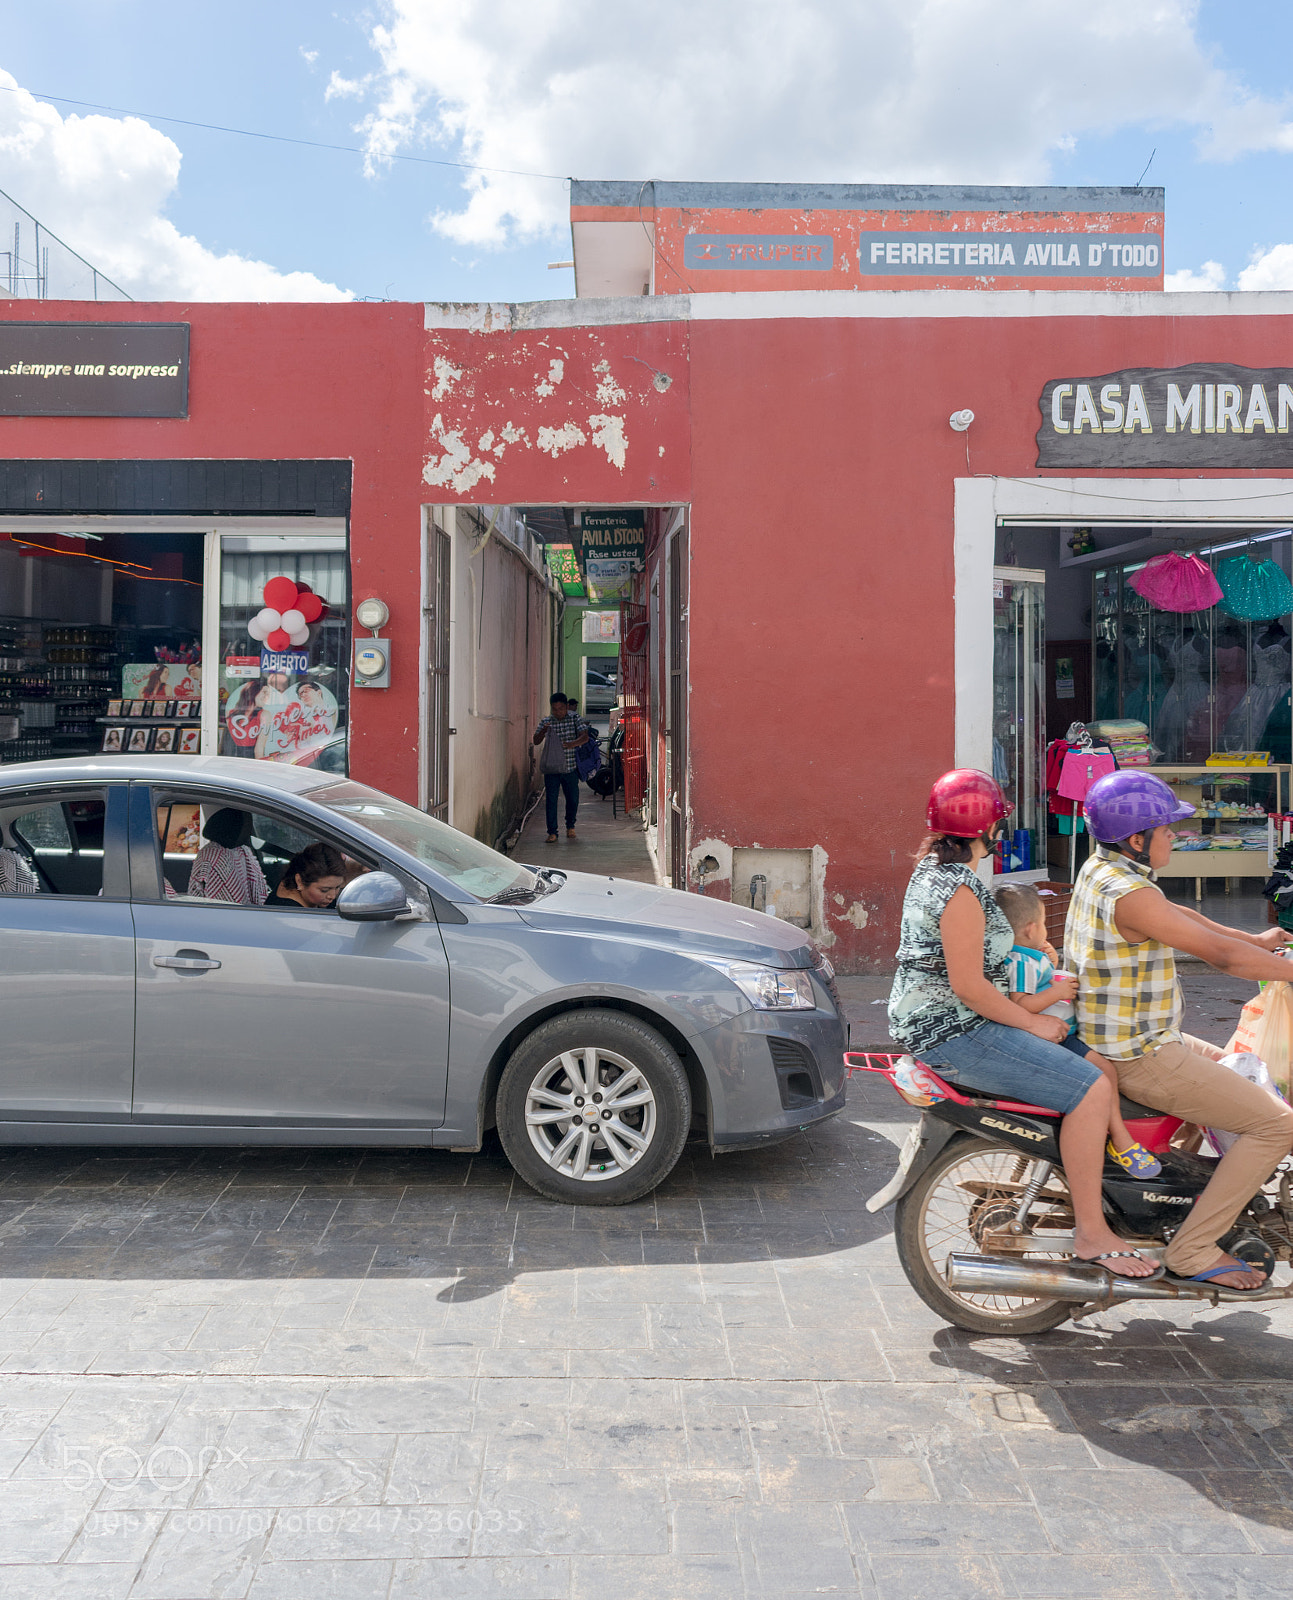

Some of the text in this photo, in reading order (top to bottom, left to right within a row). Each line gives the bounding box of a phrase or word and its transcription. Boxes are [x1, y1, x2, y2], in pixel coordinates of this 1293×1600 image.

[725, 243, 824, 262] TRUPER
[870, 242, 1159, 267] FERRETERIA AVILA D'TODO
[73, 363, 105, 377] una
[107, 364, 179, 380] sorpresa
[1051, 383, 1153, 434] CASA
[581, 529, 613, 546] AVILA
[588, 548, 638, 559] Pase usted
[261, 653, 308, 672] ABIERTO
[277, 722, 331, 750] Amor
[979, 1116, 1049, 1142] GALAXY
